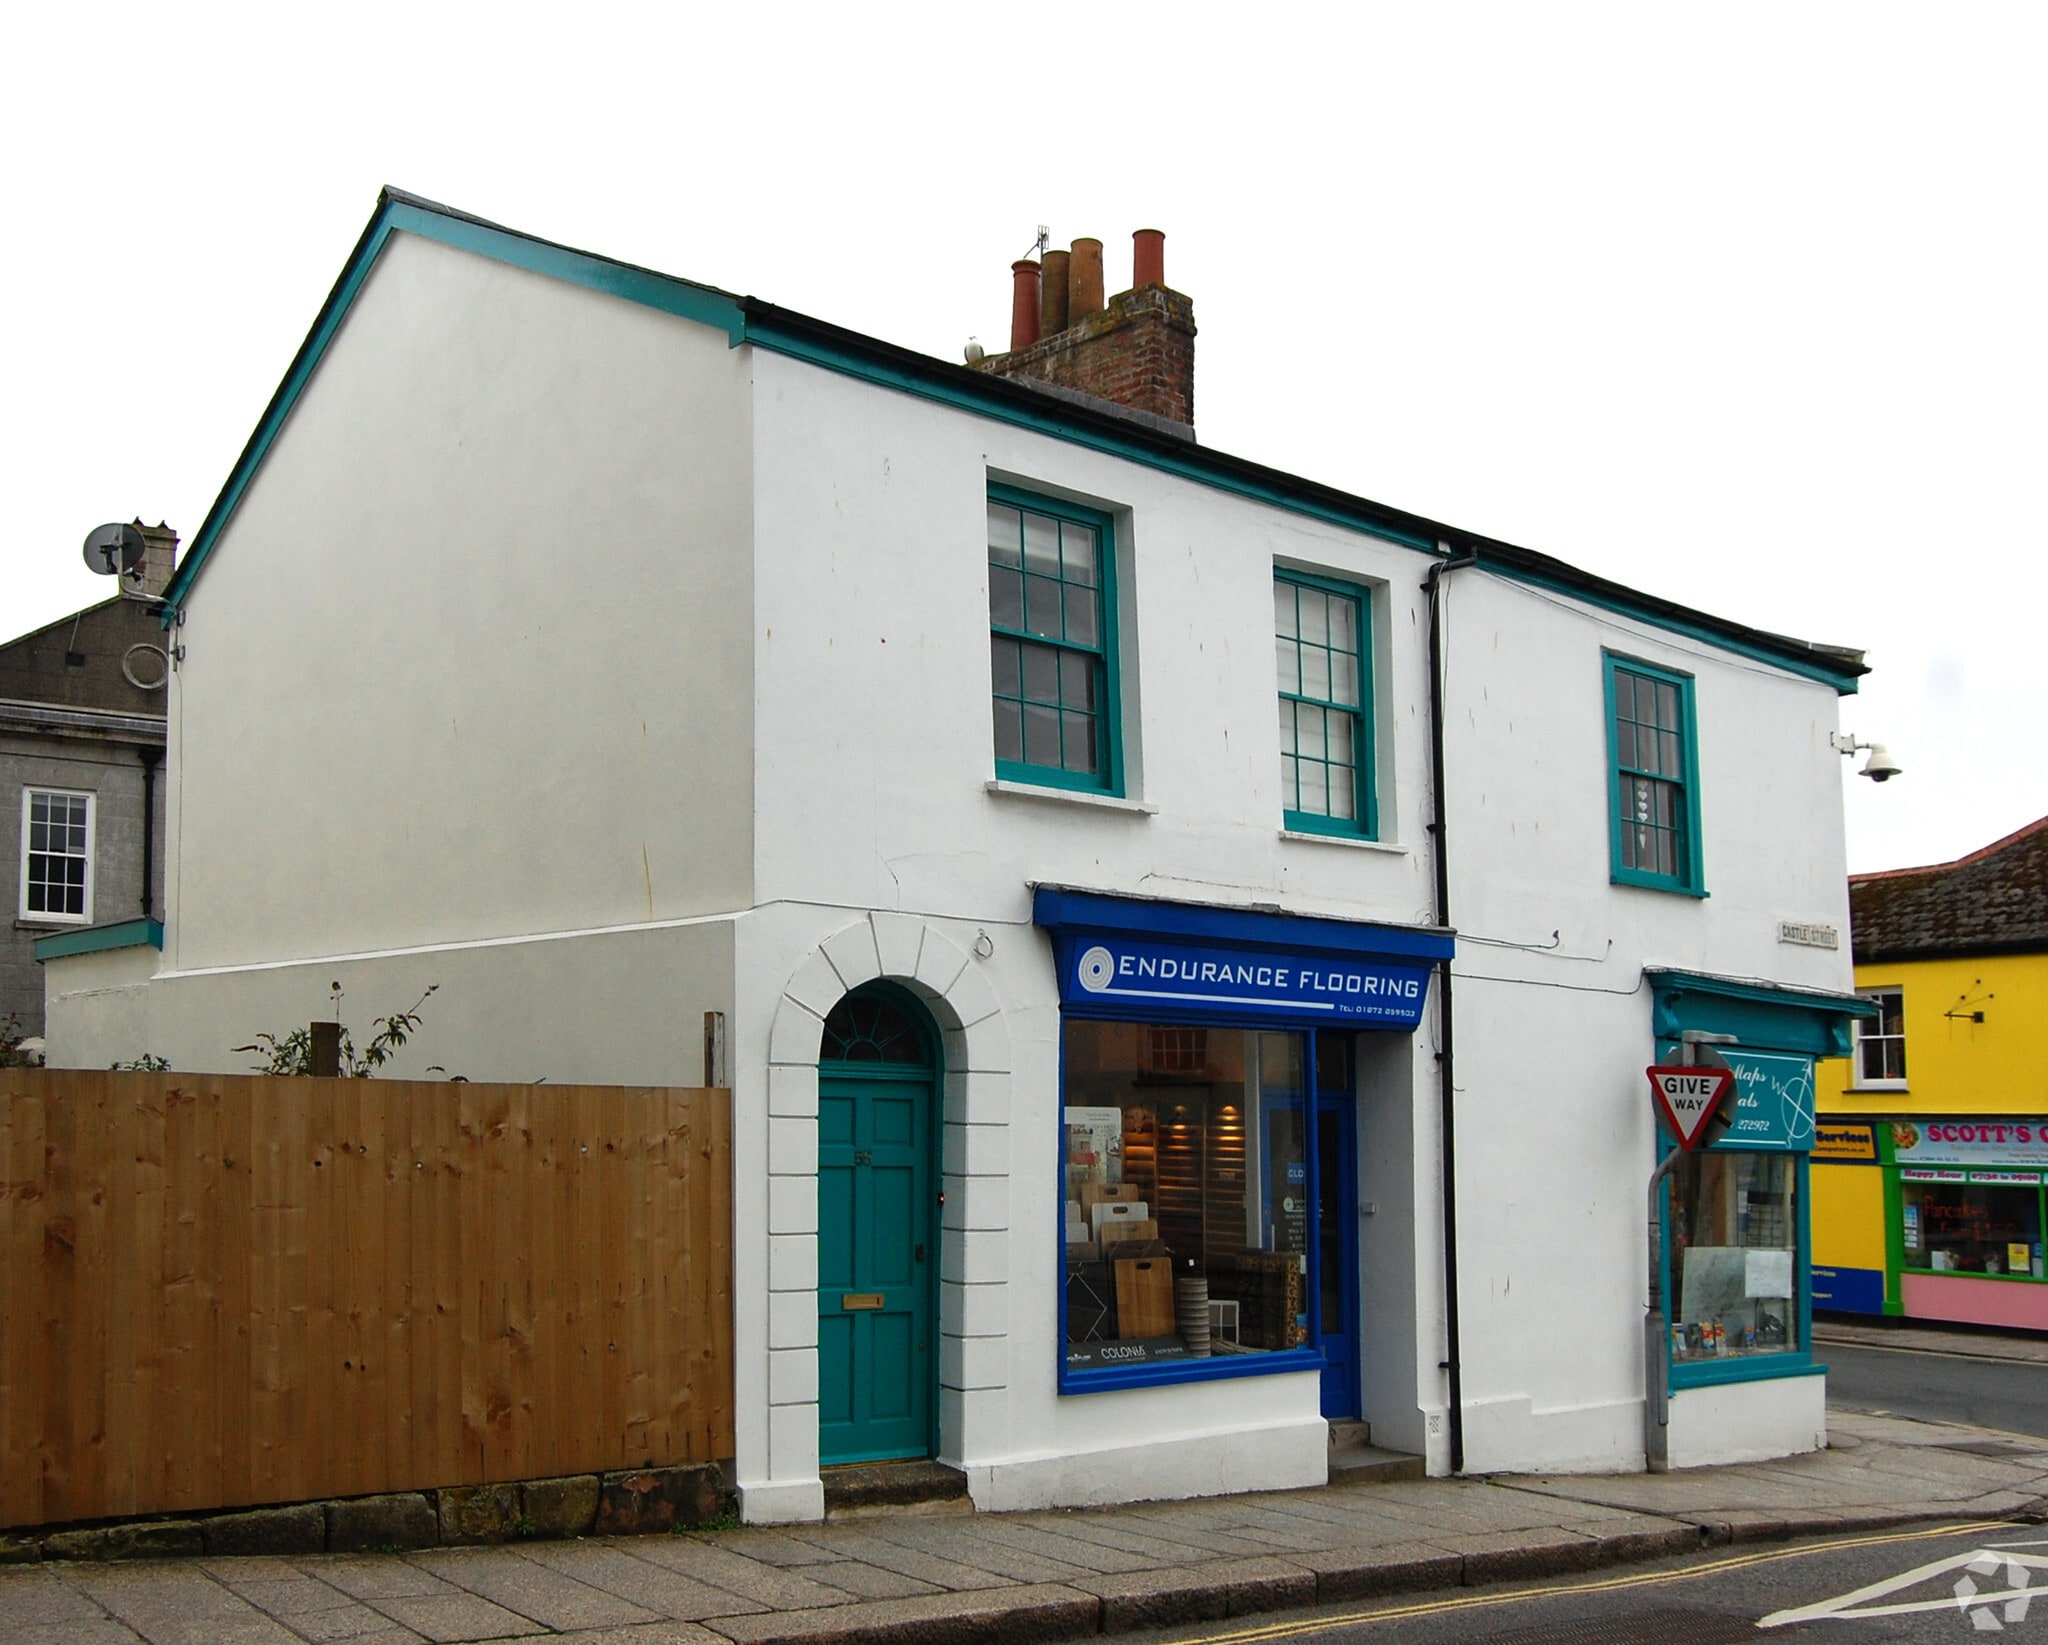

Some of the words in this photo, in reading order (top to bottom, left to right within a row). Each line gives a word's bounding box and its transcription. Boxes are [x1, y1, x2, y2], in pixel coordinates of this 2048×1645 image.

[1782, 925, 1808, 941] CASTLE
[1811, 929, 1836, 945] STREET
[1118, 955, 1289, 988] ENDURANCE
[1299, 971, 1420, 999] FLOORING
[1664, 1076, 1712, 1095] GIVE
[1674, 1099, 1704, 1111] WAY
[1927, 1124, 2032, 1144] SCOTT'S
[1287, 1169, 1304, 1178] CLO
[1903, 1169, 1935, 1179] Happy
[1937, 1170, 1963, 1179] Hour
[1101, 1345, 1147, 1360] COLONIA
